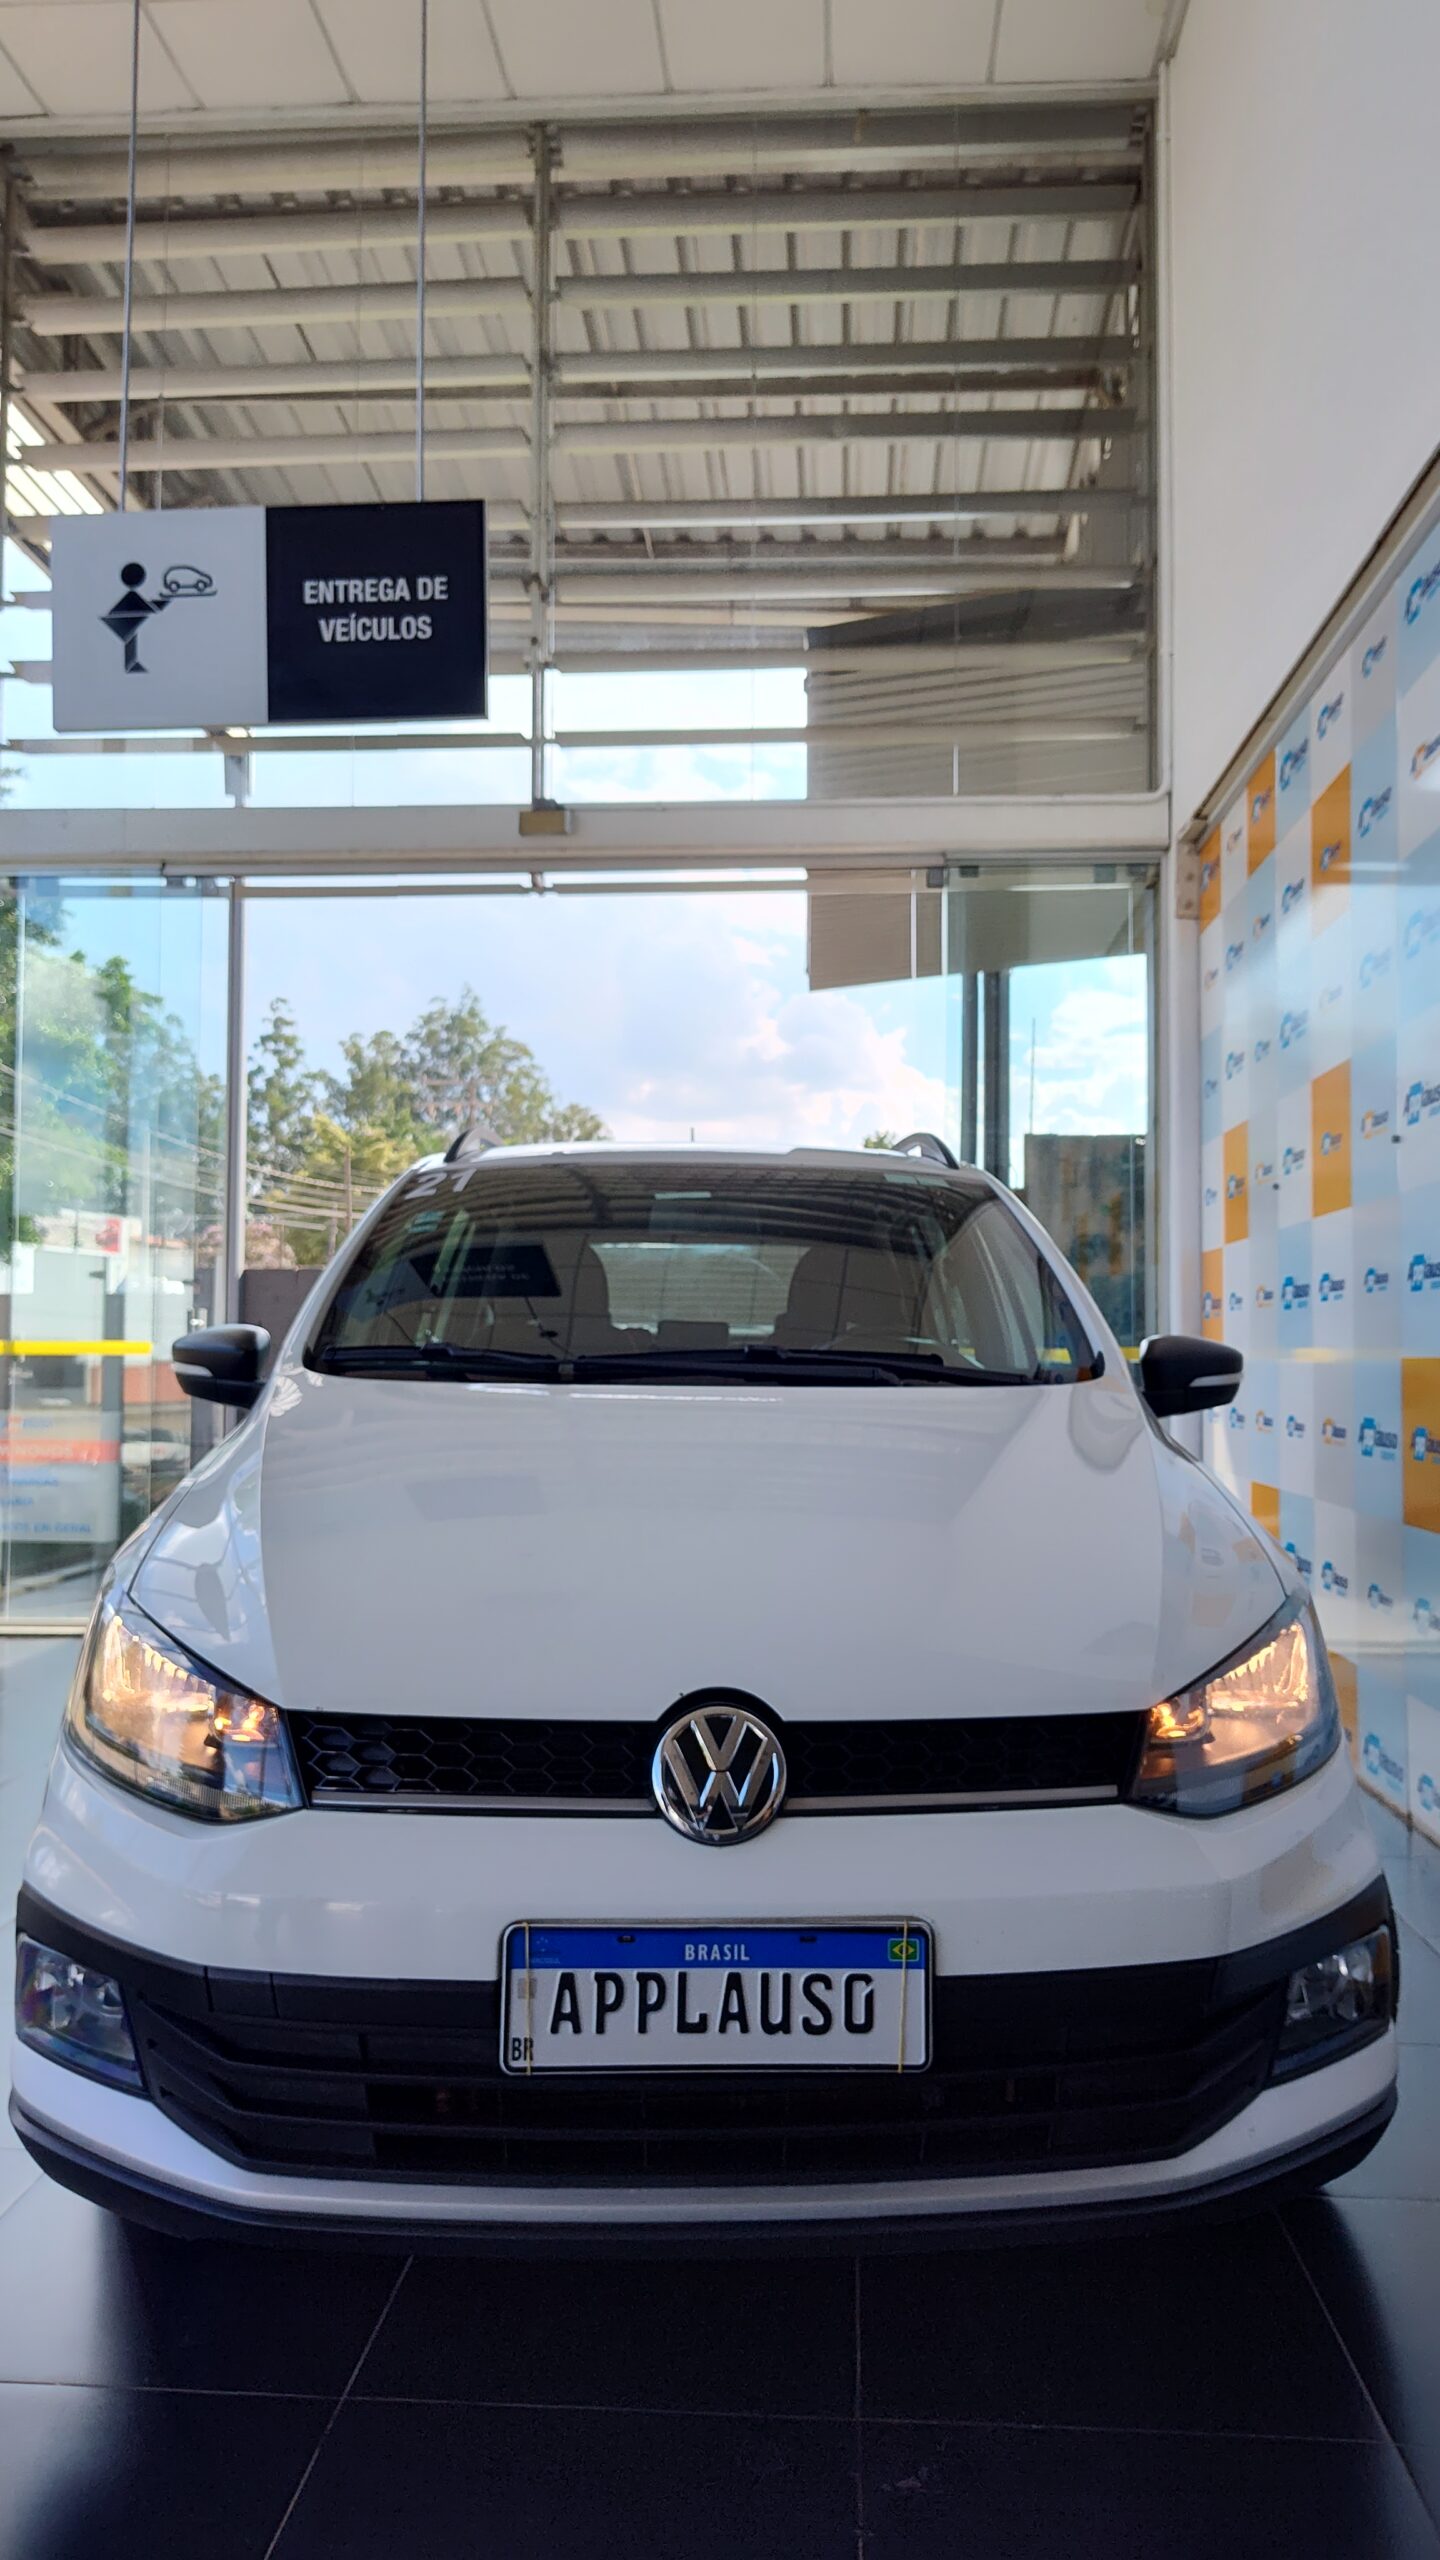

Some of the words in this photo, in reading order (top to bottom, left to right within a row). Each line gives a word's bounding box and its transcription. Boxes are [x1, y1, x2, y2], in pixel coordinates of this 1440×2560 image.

[303, 578, 411, 605] ENTREGA
[417, 576, 449, 600] DE
[318, 613, 433, 643] VEÍCULOS
[404, 1168, 477, 1200] 21
[684, 1943, 750, 1962] BRASIL
[549, 1972, 875, 2036] APPLAUSO
[511, 2037, 535, 2062] BR
